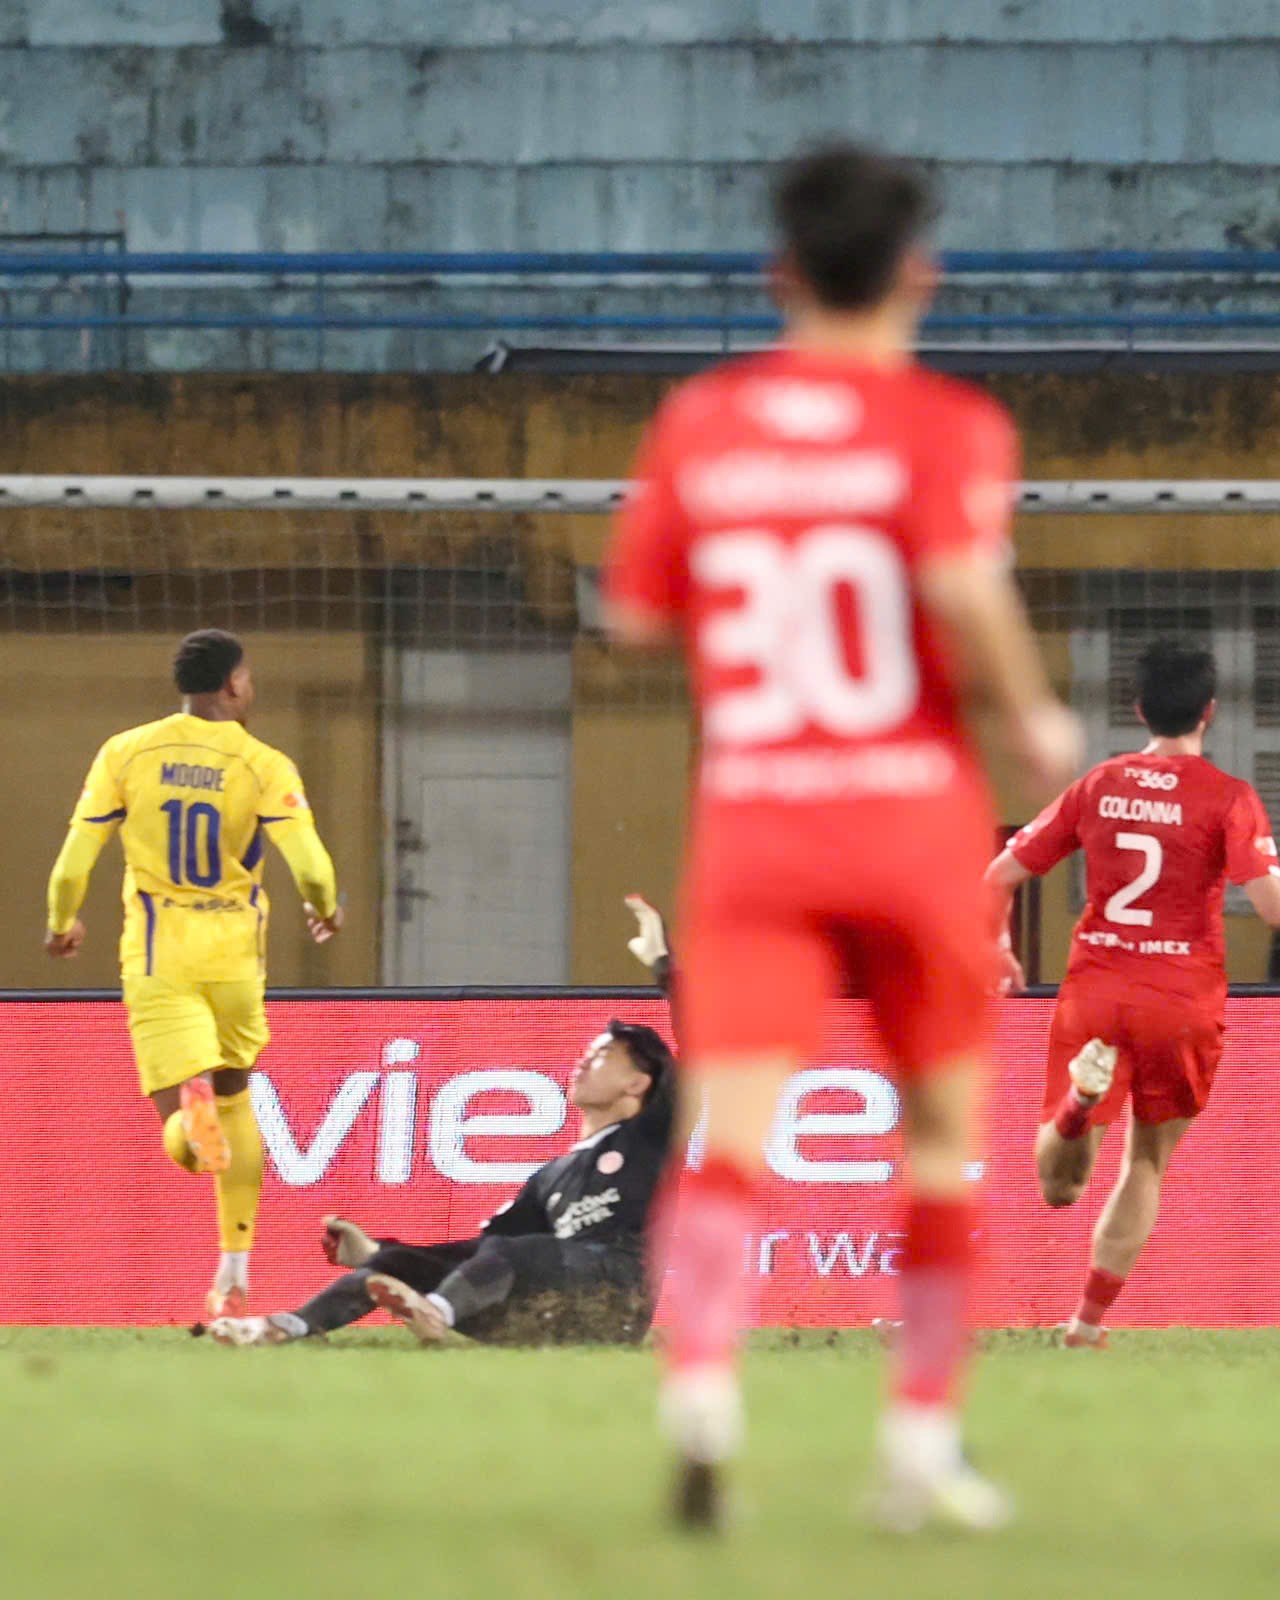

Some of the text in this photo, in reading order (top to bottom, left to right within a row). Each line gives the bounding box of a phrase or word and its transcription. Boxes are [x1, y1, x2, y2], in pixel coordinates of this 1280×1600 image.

[688, 522, 920, 742] 30
[160, 762, 226, 792] MOORE
[1098, 795, 1183, 826] COLONNA
[160, 799, 221, 888] 10
[1104, 831, 1164, 928] 2
